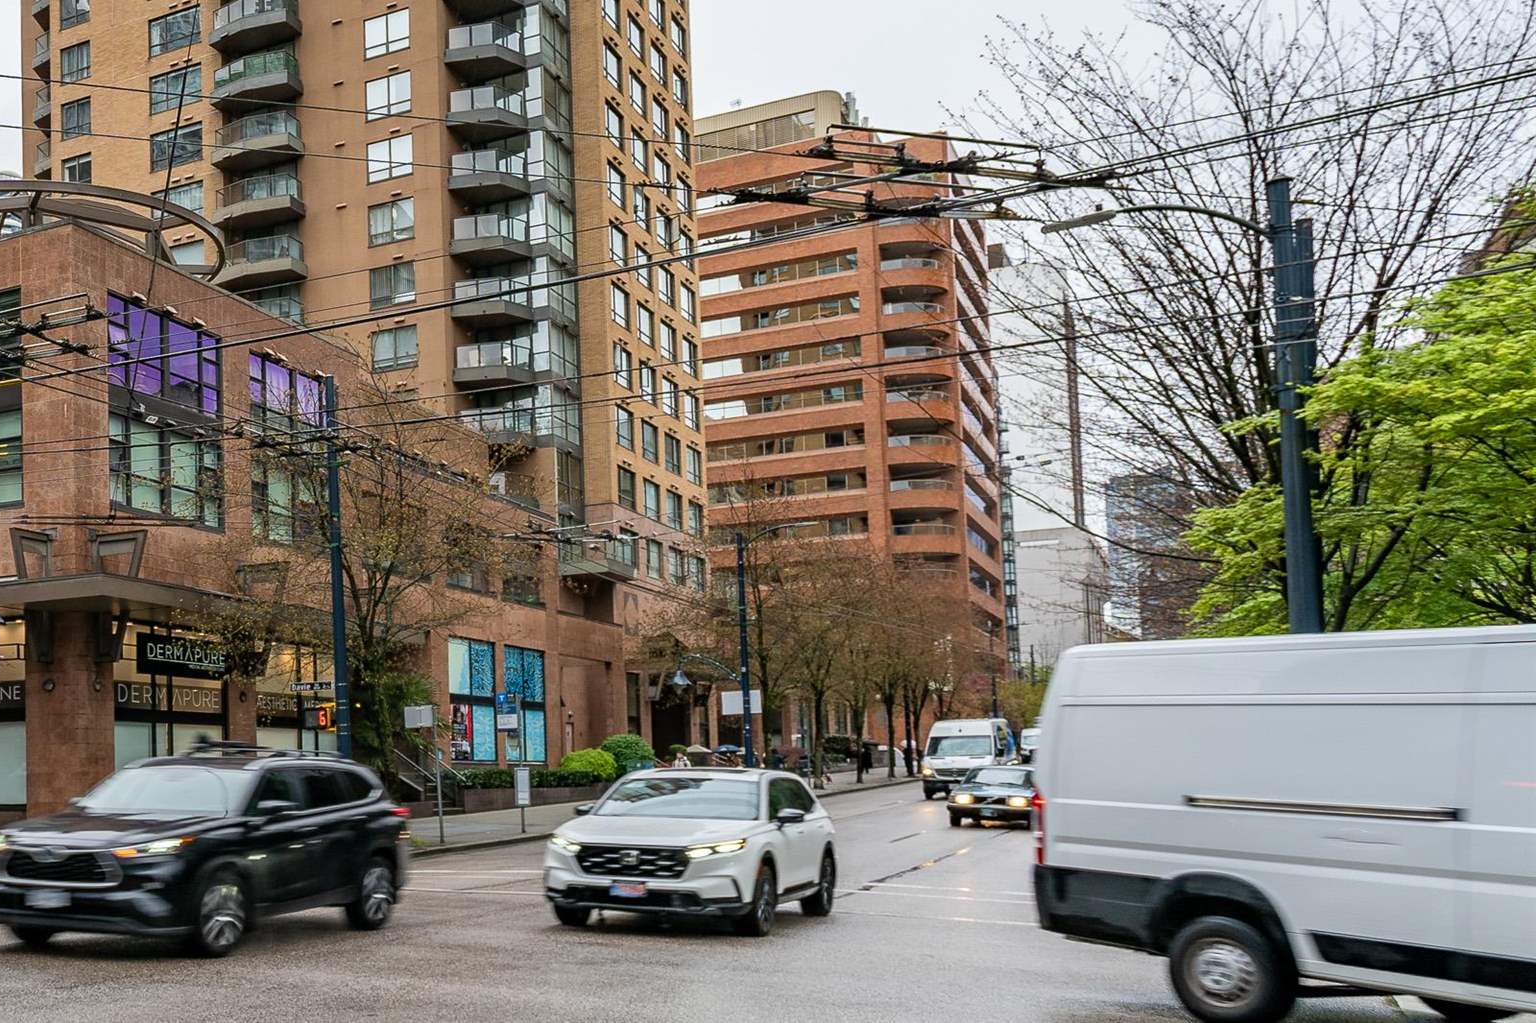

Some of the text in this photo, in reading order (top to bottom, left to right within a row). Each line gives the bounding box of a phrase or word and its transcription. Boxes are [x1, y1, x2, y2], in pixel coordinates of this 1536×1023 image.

[146, 642, 225, 665] DERMAPURE
[117, 682, 220, 709] DERMAPURE
[291, 683, 311, 691] Davie
[256, 694, 298, 712] AESTHETIC
[318, 711, 326, 726] 6
